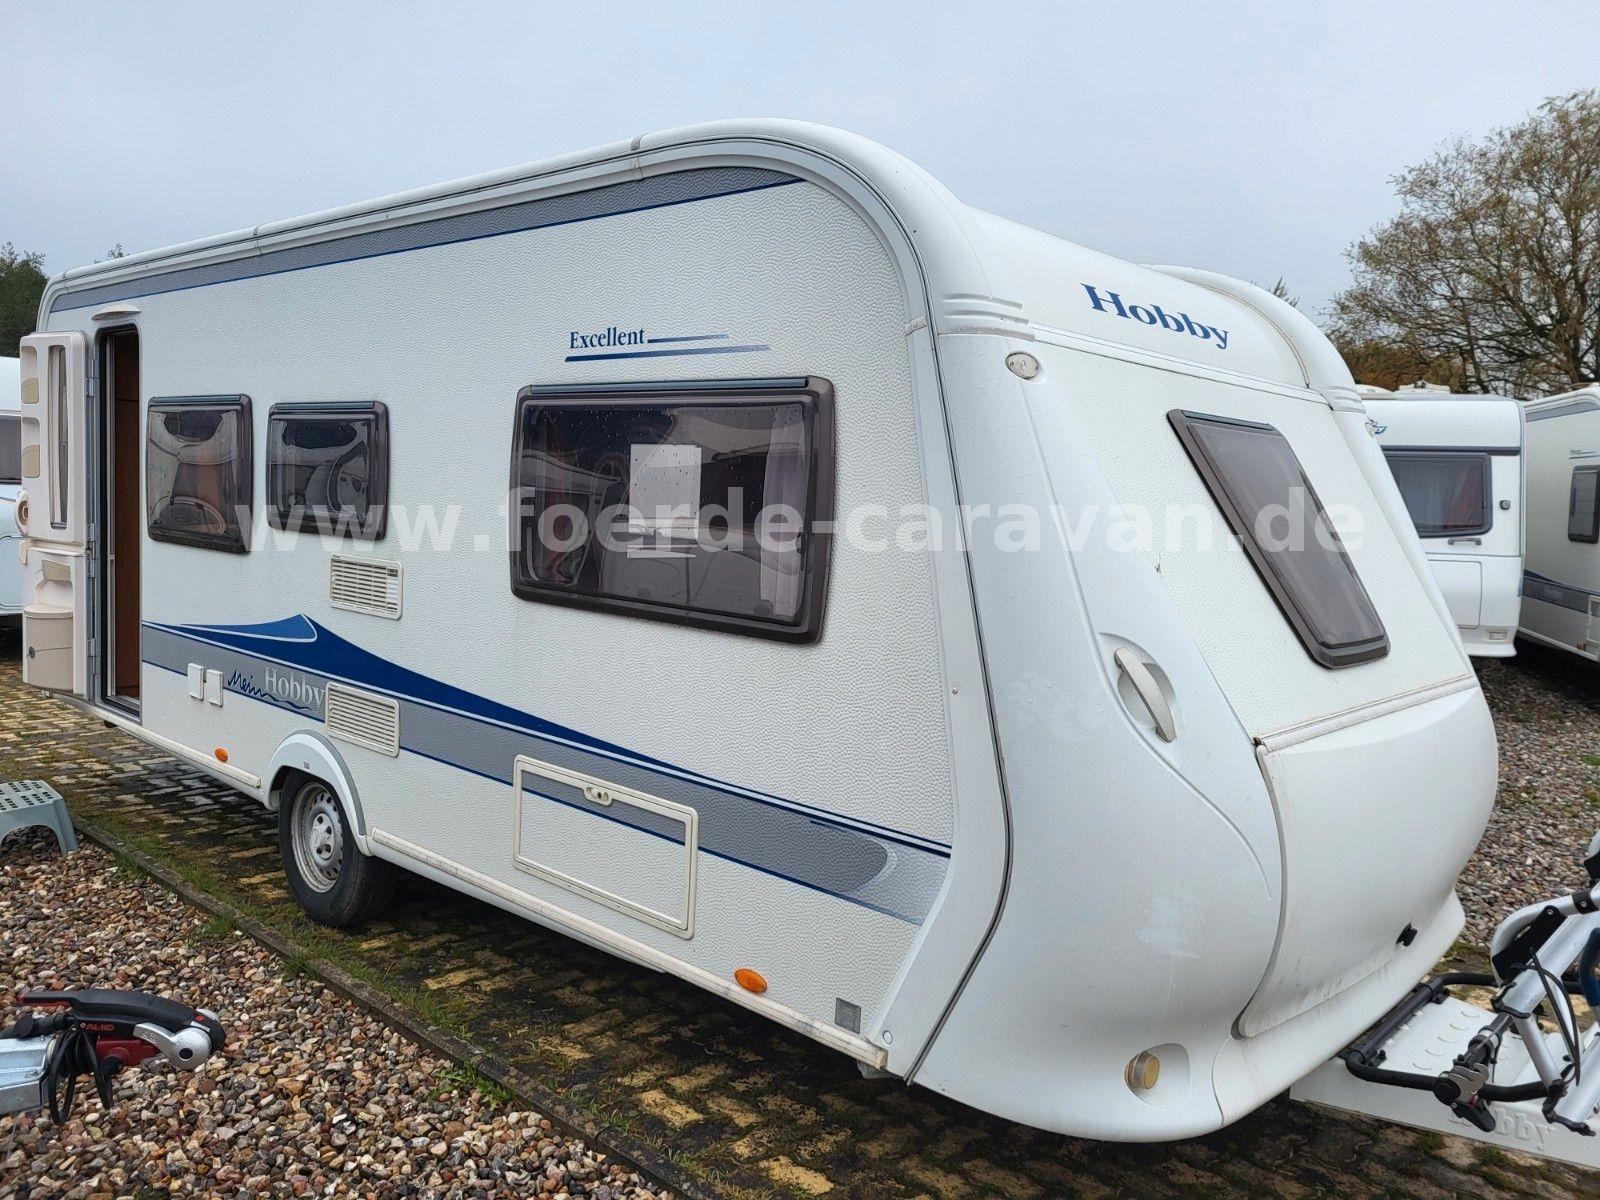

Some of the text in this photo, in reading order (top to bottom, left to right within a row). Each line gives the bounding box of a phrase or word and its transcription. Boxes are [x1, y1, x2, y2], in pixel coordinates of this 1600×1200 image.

[569, 327, 646, 349] Excellent
[1080, 283, 1229, 350] Hobby
[264, 667, 326, 710] Hobby
